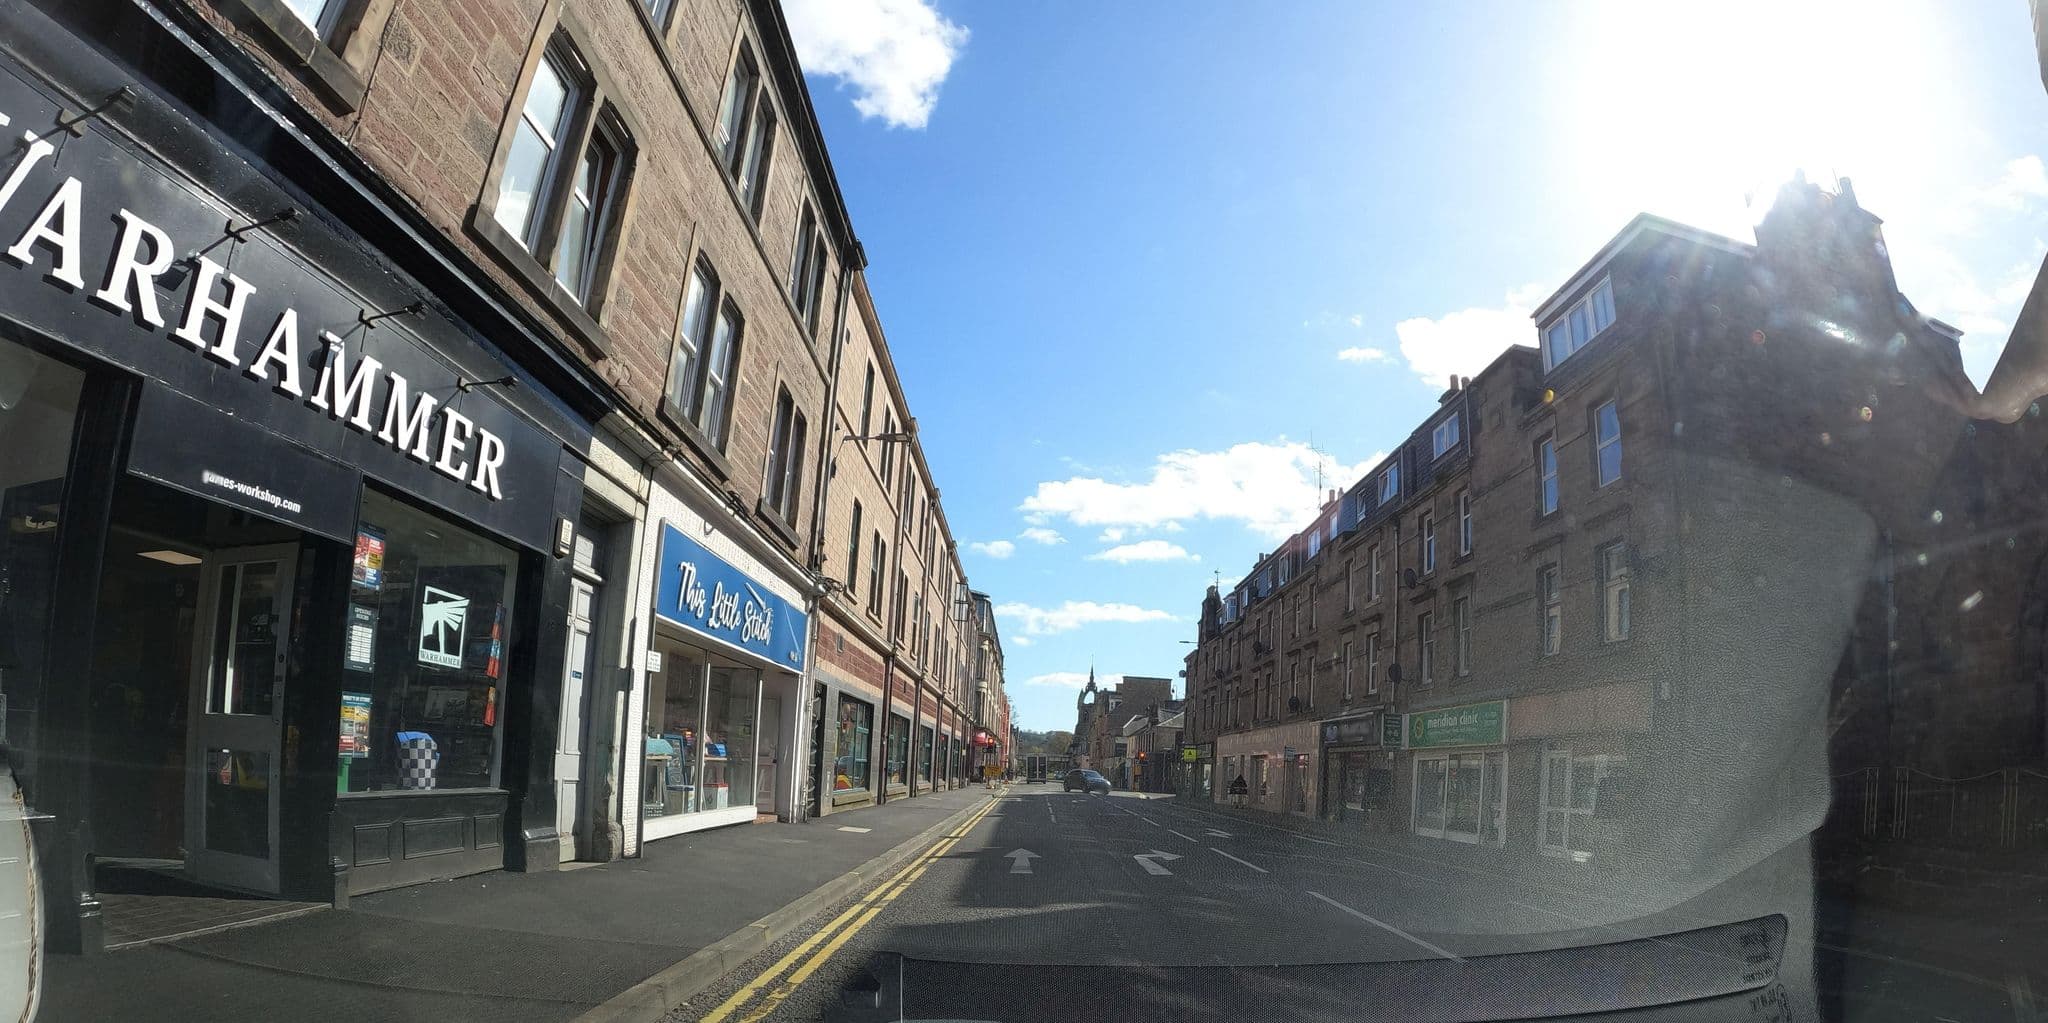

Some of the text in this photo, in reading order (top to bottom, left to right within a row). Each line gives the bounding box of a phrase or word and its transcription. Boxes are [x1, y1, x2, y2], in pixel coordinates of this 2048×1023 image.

[679, 561, 706, 618] This
[709, 581, 741, 630] Little
[1427, 712, 1457, 729] meridian
